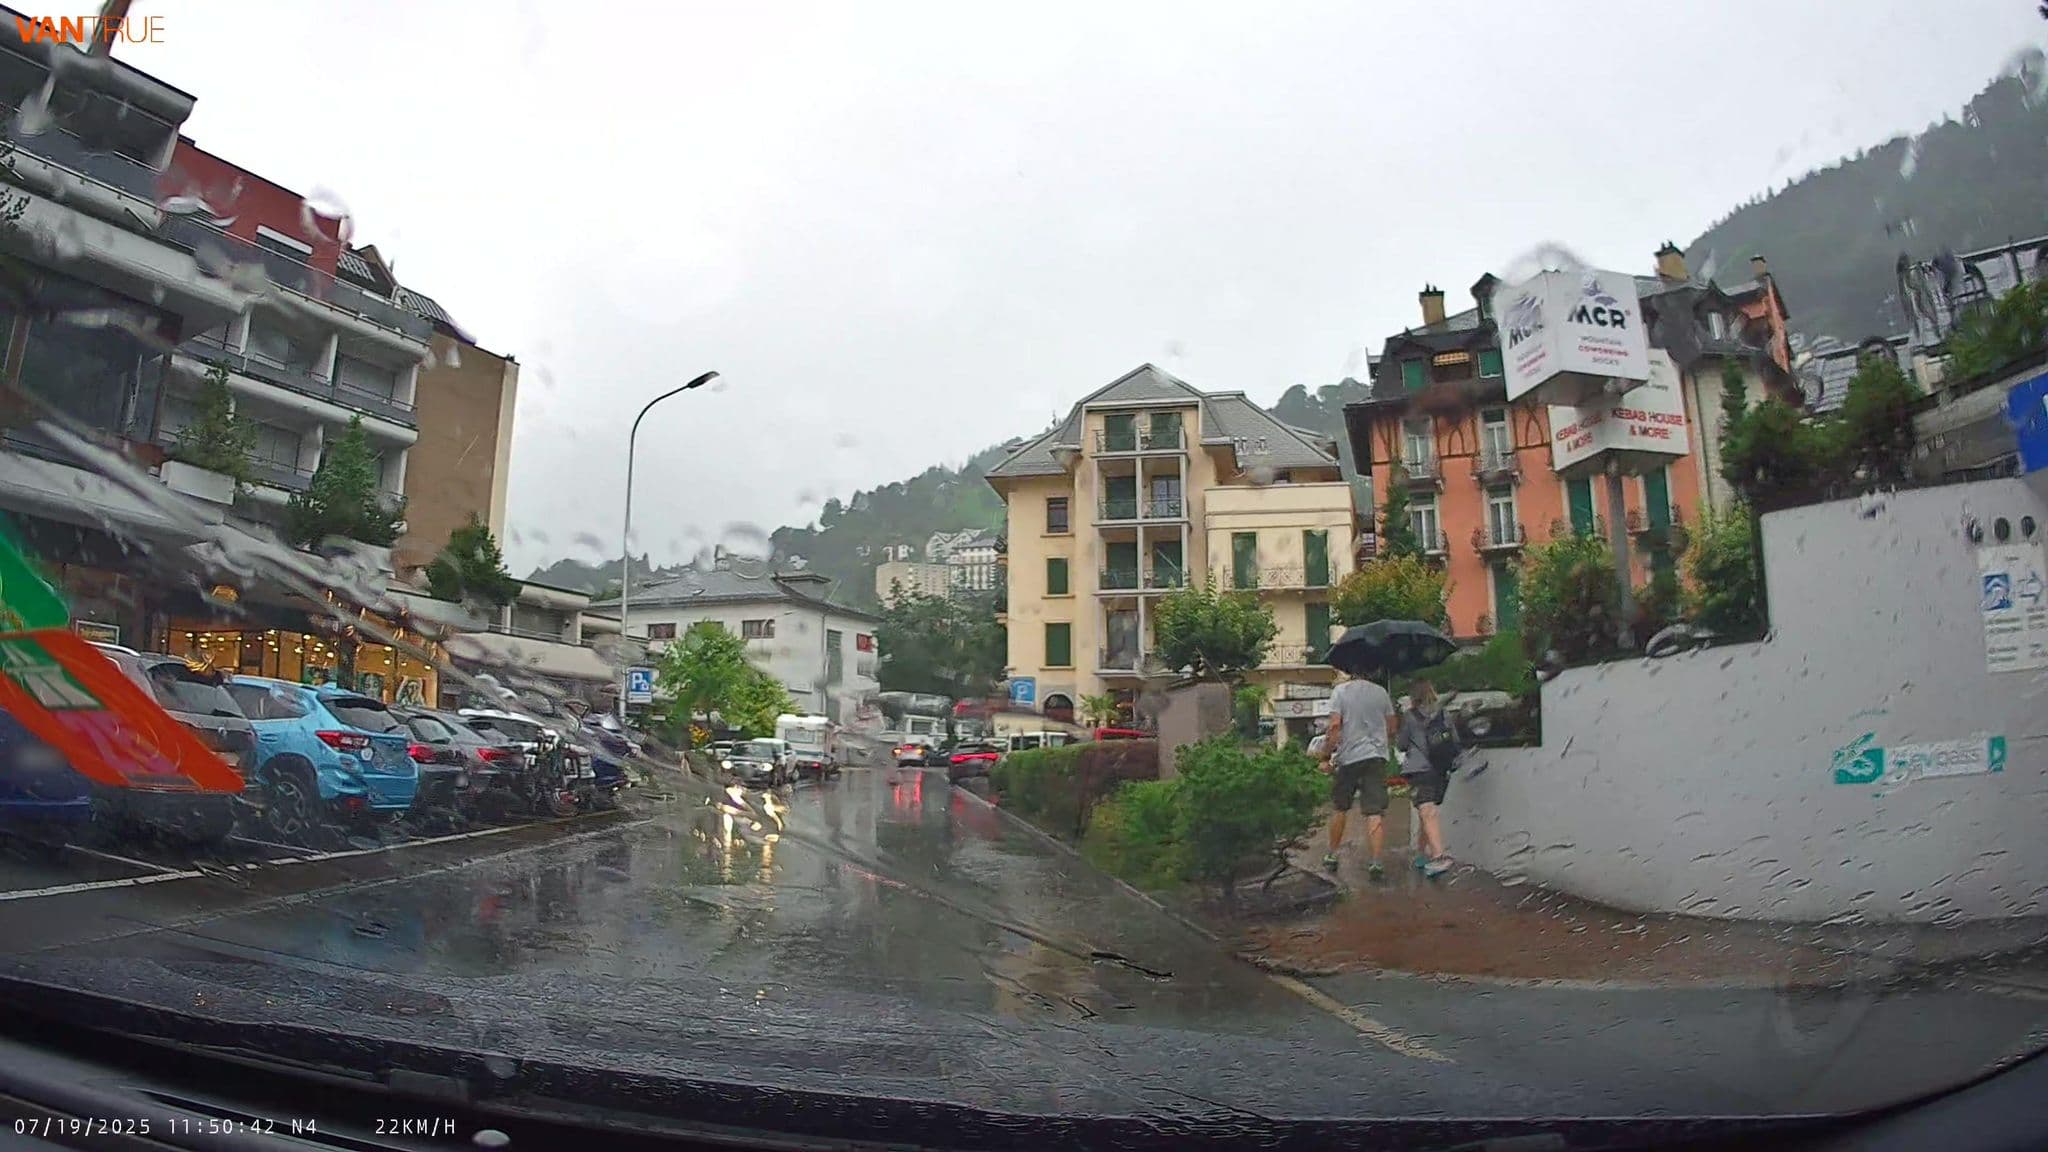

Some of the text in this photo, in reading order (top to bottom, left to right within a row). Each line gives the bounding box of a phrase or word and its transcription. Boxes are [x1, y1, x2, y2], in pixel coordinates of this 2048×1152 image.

[1611, 407, 1684, 425] KEBAB HOUSE
[632, 672, 643, 690] P
